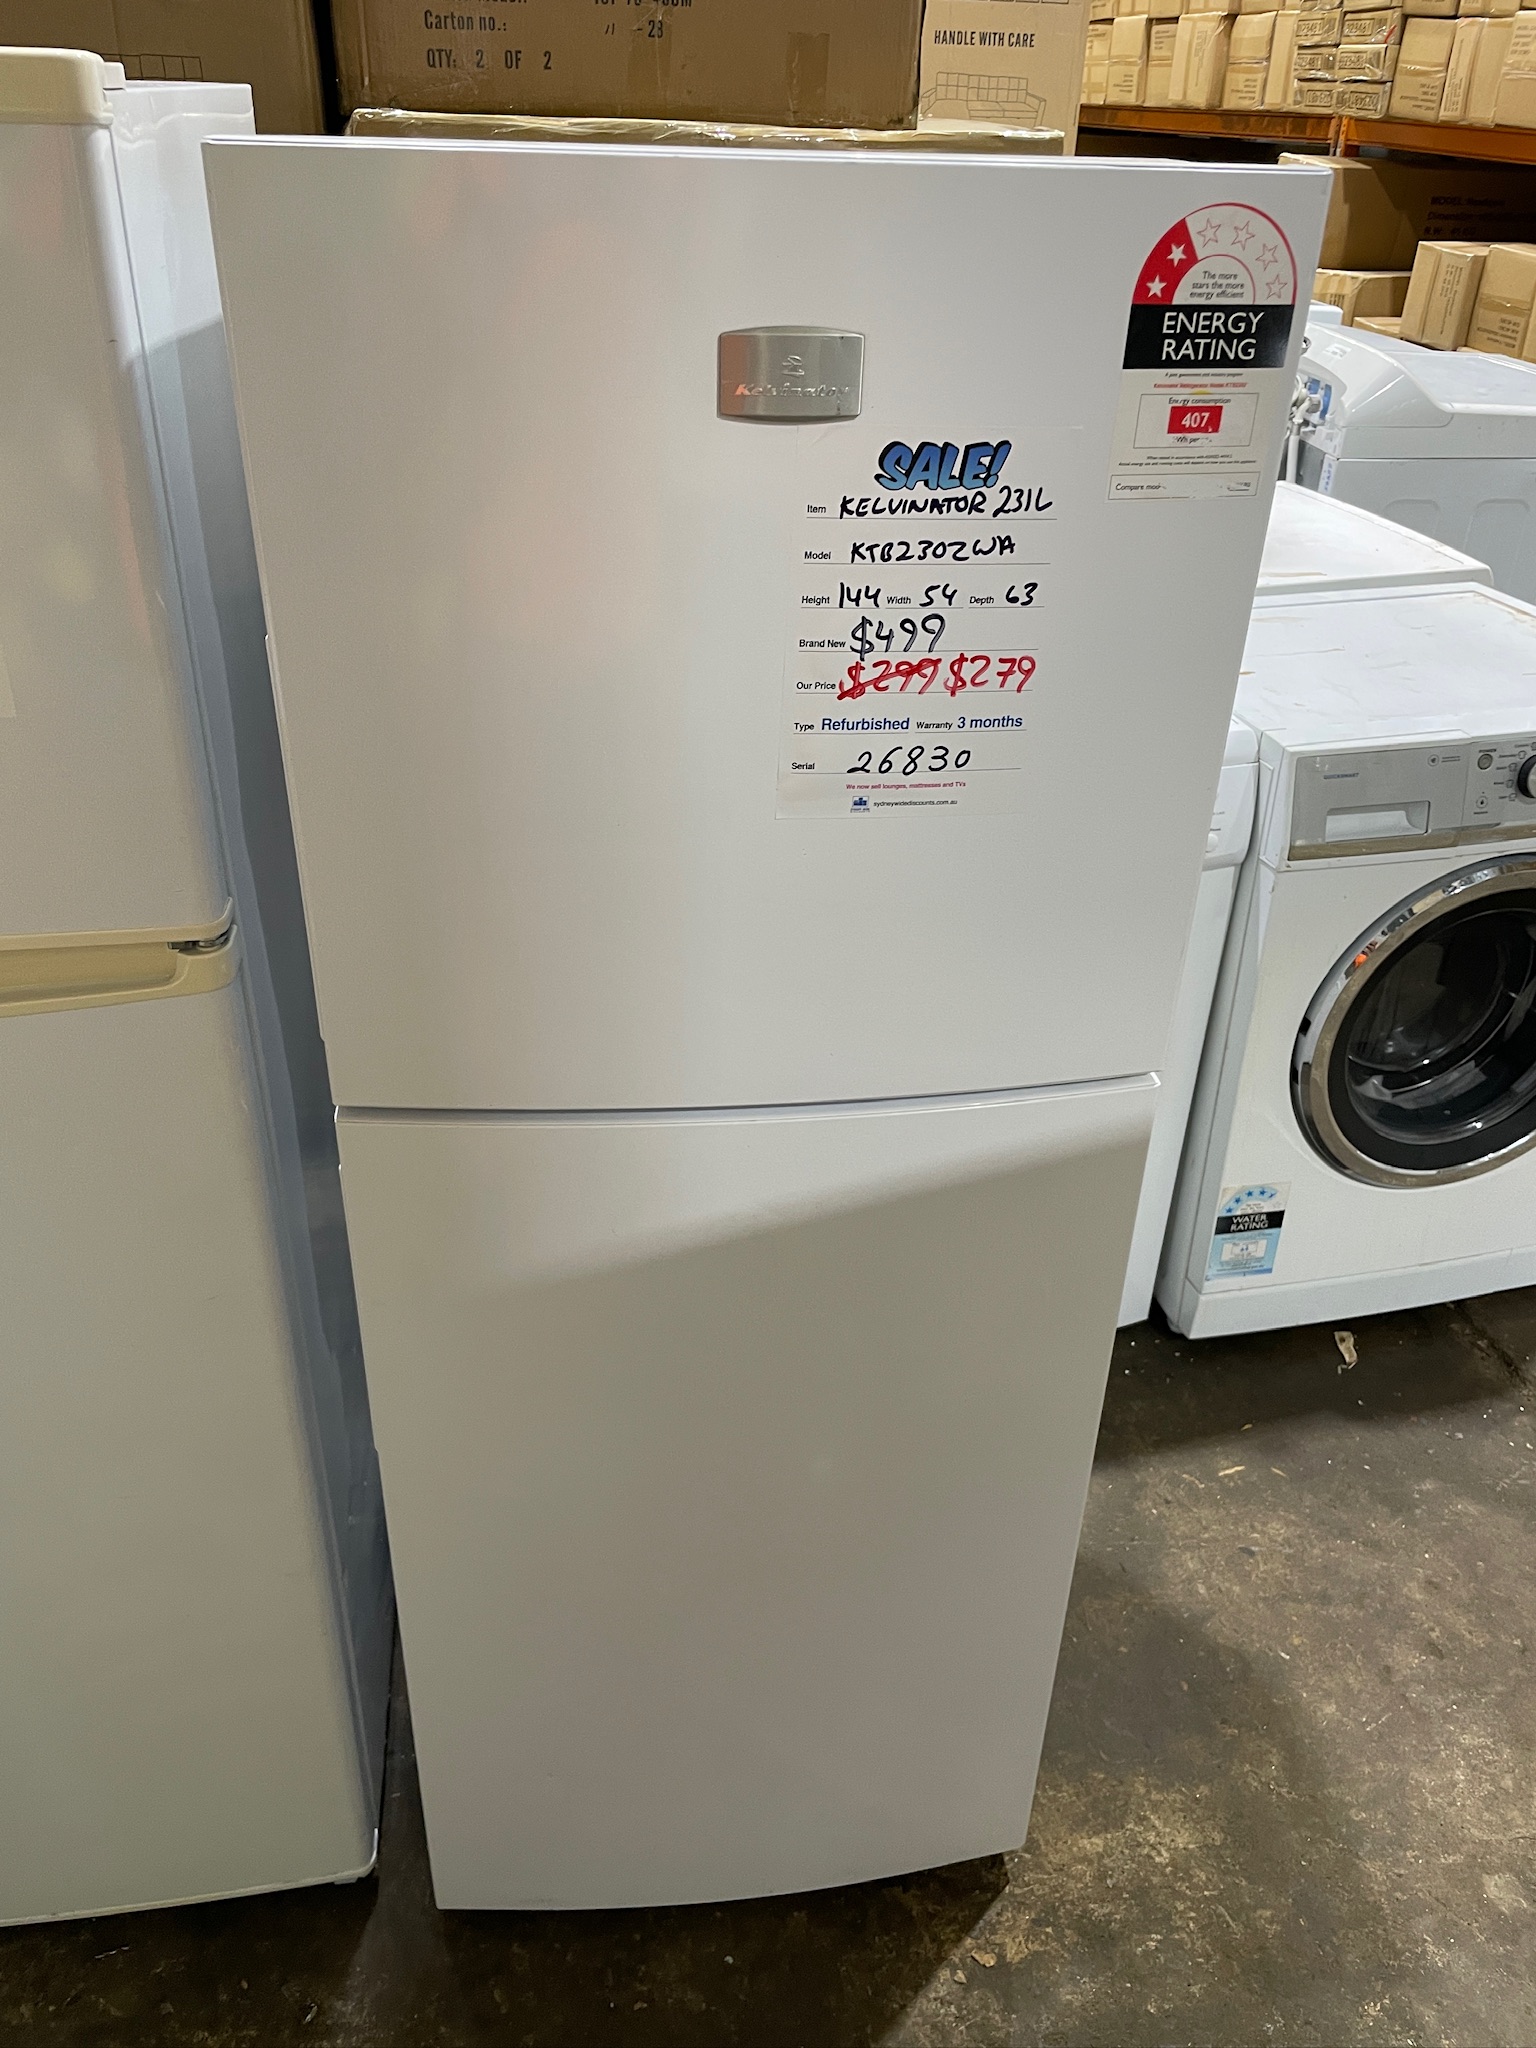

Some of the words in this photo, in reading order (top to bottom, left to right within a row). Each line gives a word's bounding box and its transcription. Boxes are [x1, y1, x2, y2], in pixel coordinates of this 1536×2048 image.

[424, 10, 474, 31] Carton
[479, 16, 507, 31] no.:
[934, 30, 976, 46] HANDLE
[979, 31, 1005, 47] WITH
[1008, 33, 1035, 48] CARE
[426, 49, 457, 69] QTY:
[476, 50, 485, 69] 2
[504, 51, 522, 70] OF
[543, 51, 552, 70] 2
[1202, 271, 1216, 280] The
[1192, 282, 1210, 290] stars
[1211, 281, 1223, 290] the
[1225, 282, 1245, 290] more
[1190, 291, 1214, 300] energy
[1216, 290, 1245, 299] efficient
[1162, 312, 1264, 334] ENERGY
[1161, 339, 1257, 361] RATING
[1181, 412, 1210, 428] 407
[874, 440, 1012, 490] SALE!
[1116, 483, 1144, 491] Compare
[807, 504, 826, 513] Item
[839, 491, 987, 519] KELVINATOR
[992, 485, 1053, 518] 231L
[804, 551, 831, 560] Model
[801, 596, 830, 606] Height
[839, 582, 881, 608] 144
[886, 596, 911, 604] Width
[919, 583, 958, 607] 54
[969, 596, 994, 605] Depth
[1005, 582, 1038, 606] 63
[799, 639, 825, 648] Brand
[827, 640, 846, 648] New
[849, 613, 946, 662] $499
[796, 682, 812, 690] Our
[814, 681, 836, 690] Price
[943, 653, 1036, 697] $279
[794, 722, 815, 732] Type
[821, 717, 910, 730] Refurbished
[916, 721, 953, 731] Warranty
[957, 716, 966, 729] 3
[969, 715, 1023, 728] months
[791, 762, 815, 770] Serial
[847, 746, 971, 776] 26830
[873, 800, 958, 808] sydneywidediscounts.com.au
[1230, 1221, 1269, 1233] RATING
[1232, 1214, 1267, 1224] WATER
